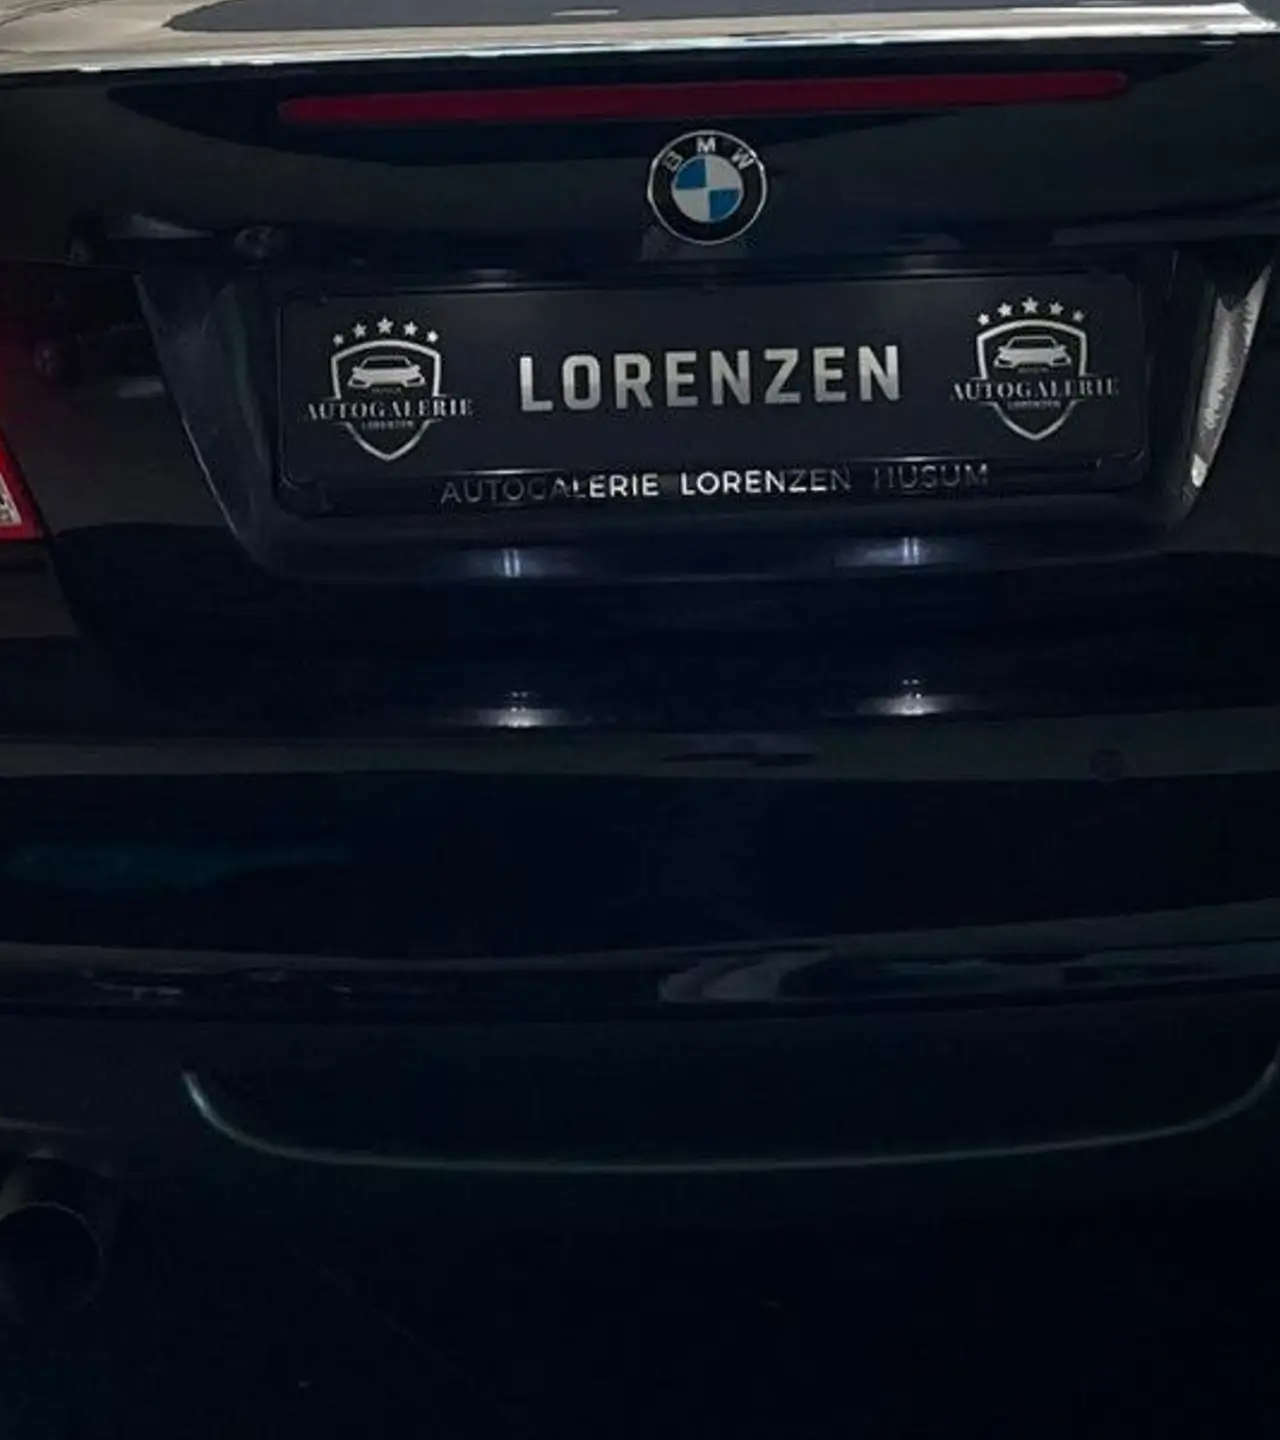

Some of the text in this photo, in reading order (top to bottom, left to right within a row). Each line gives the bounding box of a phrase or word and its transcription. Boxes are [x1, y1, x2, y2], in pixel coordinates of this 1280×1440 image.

[661, 137, 754, 172] BMW
[519, 344, 902, 412] LORENZEN
[950, 377, 1119, 401] AUTOGALERIE
[298, 398, 474, 423] AUTOGALERIE
[440, 462, 989, 504] AUTOGALERIE LORENZEN HUSUM
